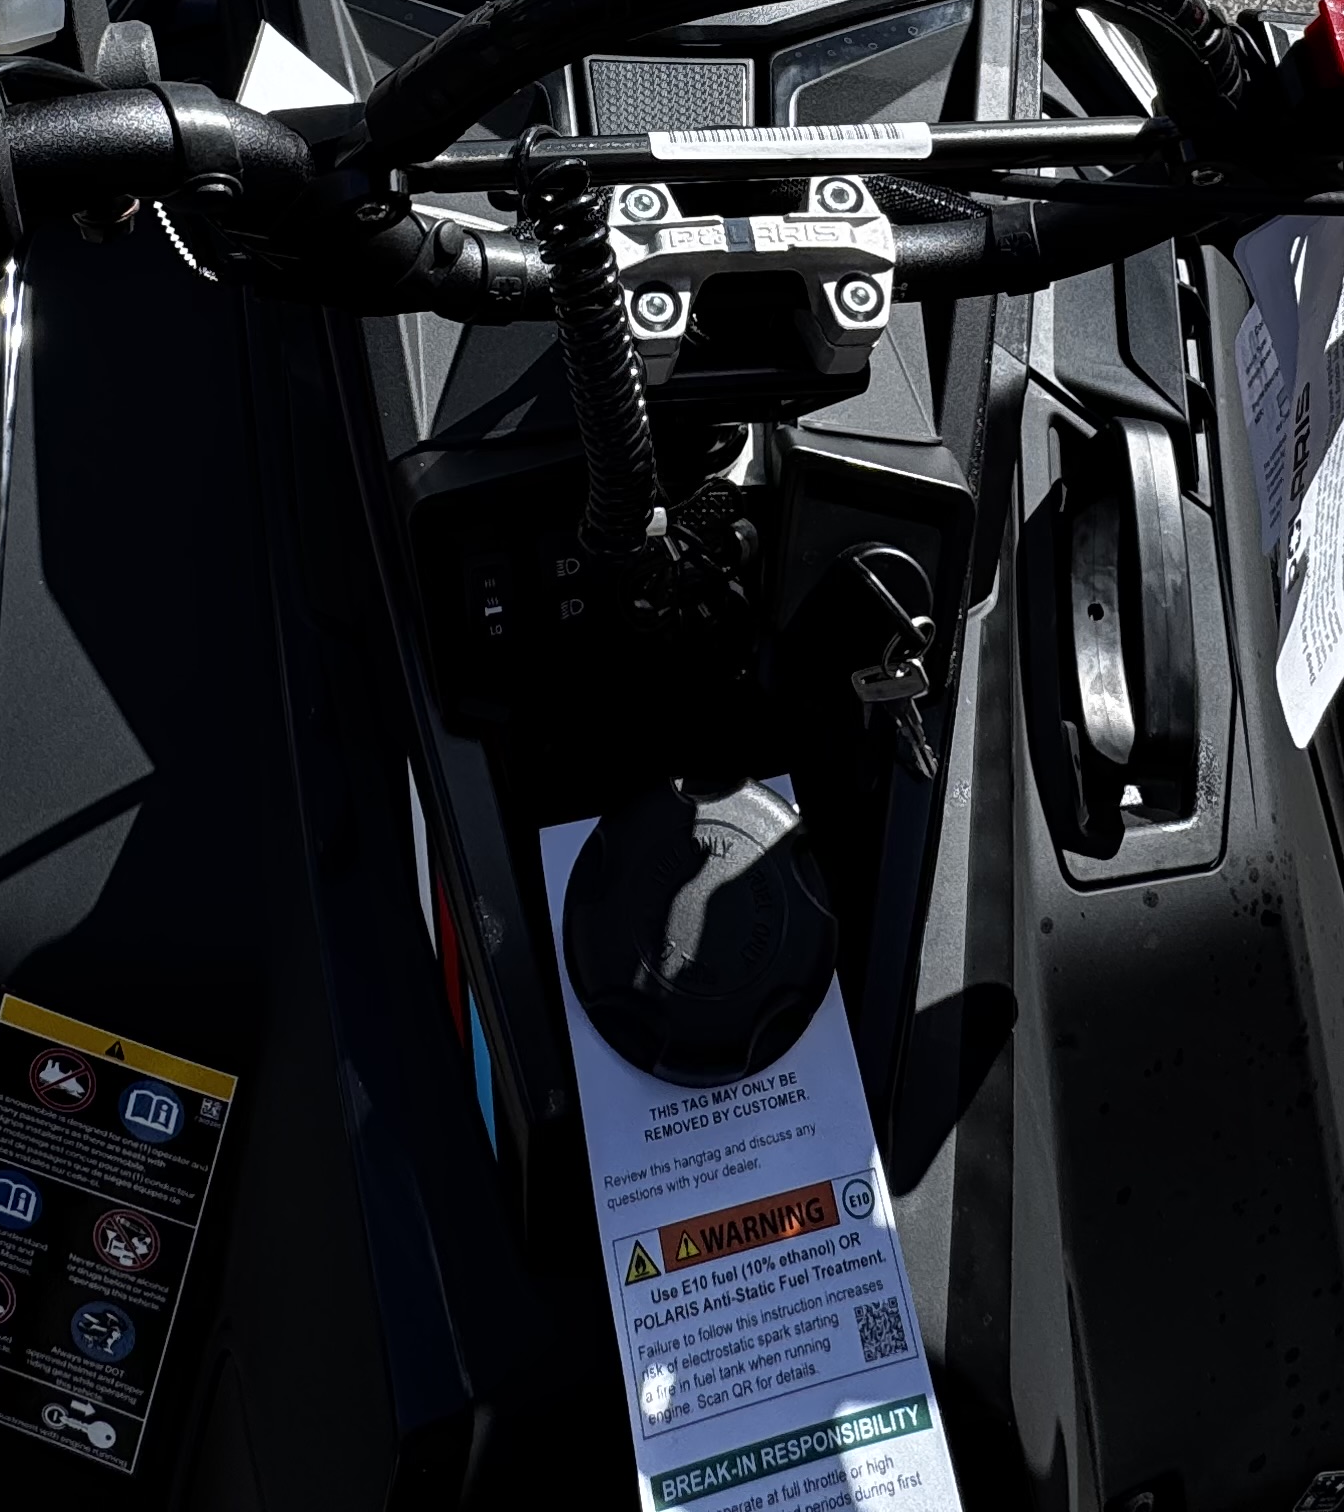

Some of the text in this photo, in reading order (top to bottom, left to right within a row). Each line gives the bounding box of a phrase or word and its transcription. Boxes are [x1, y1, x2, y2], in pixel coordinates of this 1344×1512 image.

[667, 223, 841, 248] POLARIS
[1286, 381, 1312, 594] POLARIS
[644, 1085, 809, 1144] REMOVED BY CUSTOMER.
[651, 1071, 796, 1121] THIS TAG MAY ONLY BE
[603, 1121, 816, 1189] Review this hangtag and discuss any
[607, 1156, 760, 1209] questions with your dealer.
[700, 1191, 869, 1253] WARNING E10
[634, 1247, 886, 1332] POLARIS Anti-Static Fuel Treatment.
[651, 1232, 860, 1303] Use E10 fuel (10% ethanol) OR
[638, 1276, 883, 1359] Failure to follow this instruction increases
[642, 1311, 839, 1380] risk of electrostatic spark starting
[646, 1334, 830, 1402] a fire in fuel tank when running
[648, 1360, 816, 1428] engine. Scan QR for details.
[661, 1402, 921, 1501] BREAK-IN RESPONSIBILITY
[768, 1491, 778, 1504] at
[782, 1484, 800, 1501] full
[805, 1471, 845, 1493] throttle
[852, 1467, 861, 1478] or
[867, 1456, 893, 1475] high
[856, 1479, 894, 1500] during
[898, 1472, 921, 1488] first
